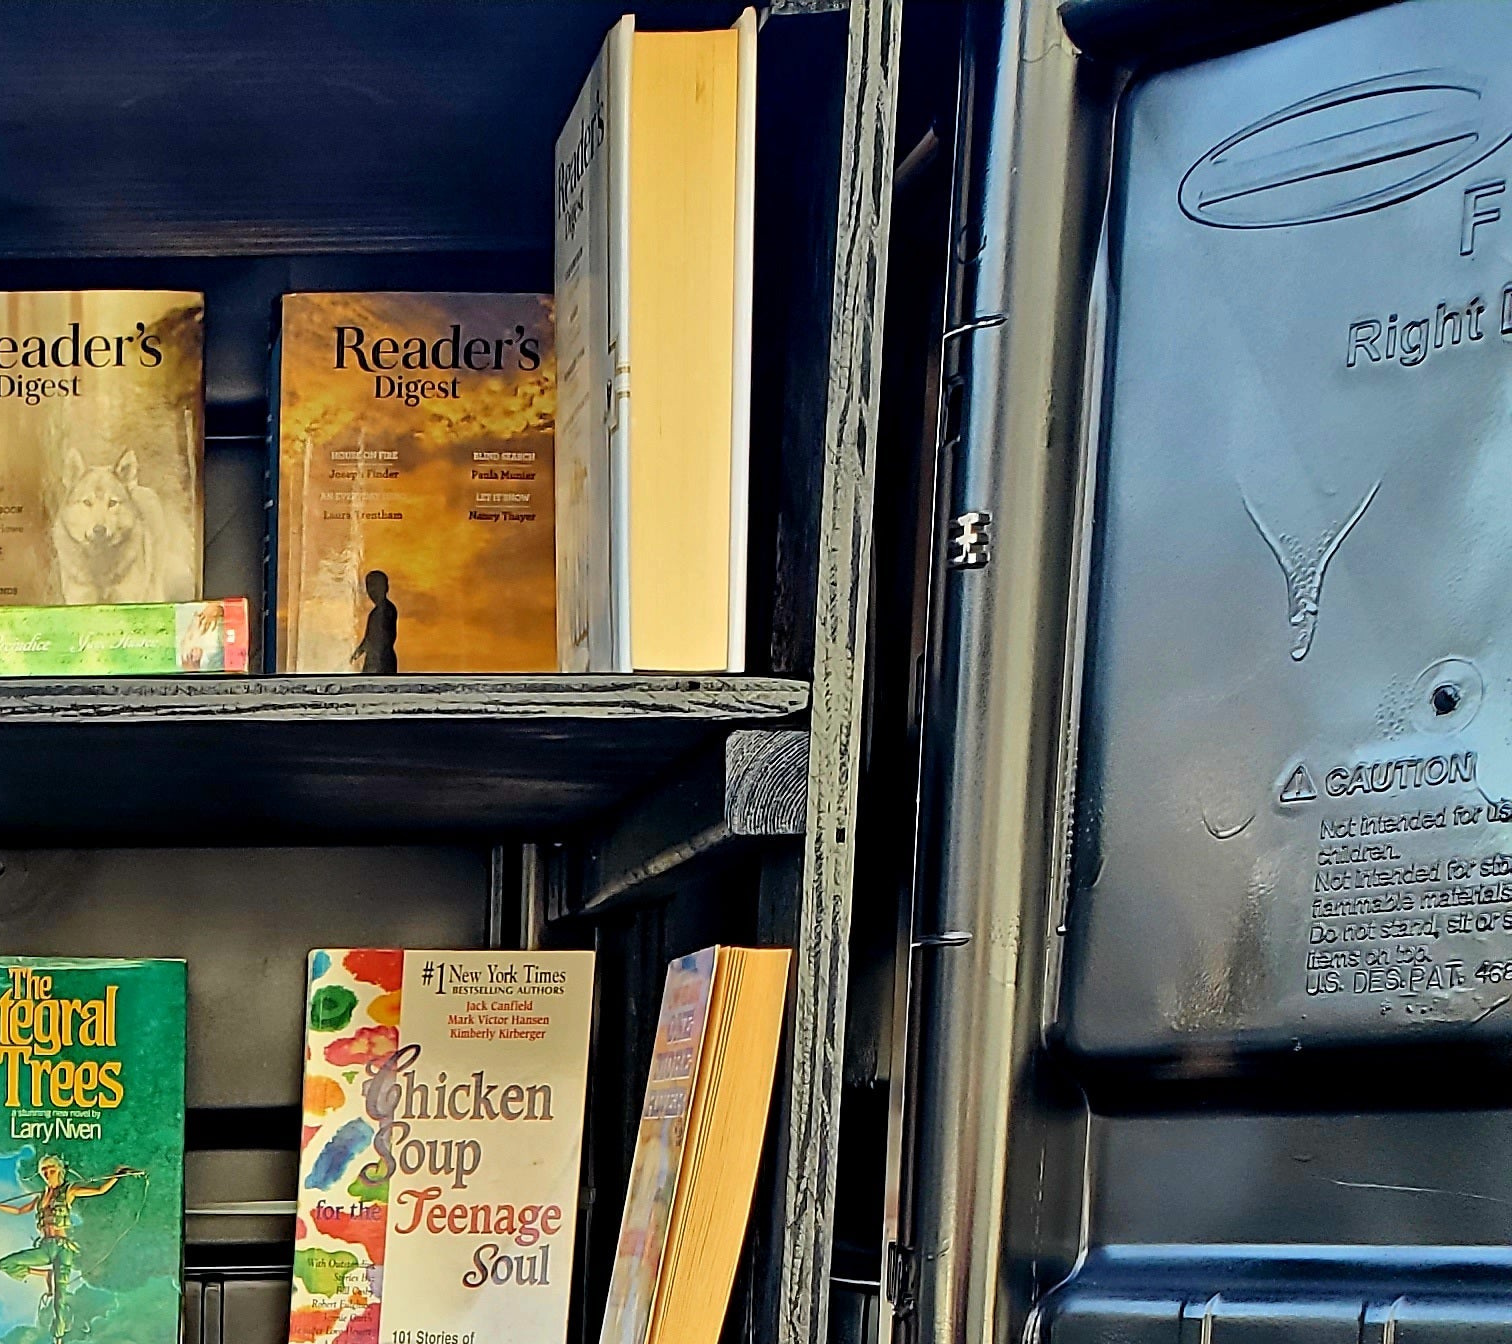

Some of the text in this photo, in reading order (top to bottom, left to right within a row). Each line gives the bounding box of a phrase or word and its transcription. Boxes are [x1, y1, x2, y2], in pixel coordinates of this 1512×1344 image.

[334, 324, 541, 372] Reader's
[1346, 296, 1485, 368] Right
[373, 374, 461, 408] Digest
[1325, 752, 1473, 797] CAUTION
[1312, 889, 1414, 918] flammable
[1309, 922, 1338, 944] Do
[1344, 921, 1376, 942] not
[1447, 912, 1473, 934] sit
[9, 967, 52, 1000] The
[422, 962, 566, 995] #1 New York Times
[452, 986, 565, 995] BESTSELLING AUTHORS
[448, 1014, 549, 1026] Mark Victor Hansen
[466, 1000, 533, 1012] Jack Canfield
[450, 1027, 546, 1041] Kimberly Kirberger
[362, 1044, 554, 1121] Chicken
[11, 1117, 101, 1143] Larry Niven
[360, 1121, 481, 1189] Soup
[316, 1199, 382, 1221] for the
[395, 1187, 561, 1246] Teenage
[462, 1244, 550, 1288] Soul
[392, 1331, 413, 1344] 101
[461, 1331, 475, 1344] of
